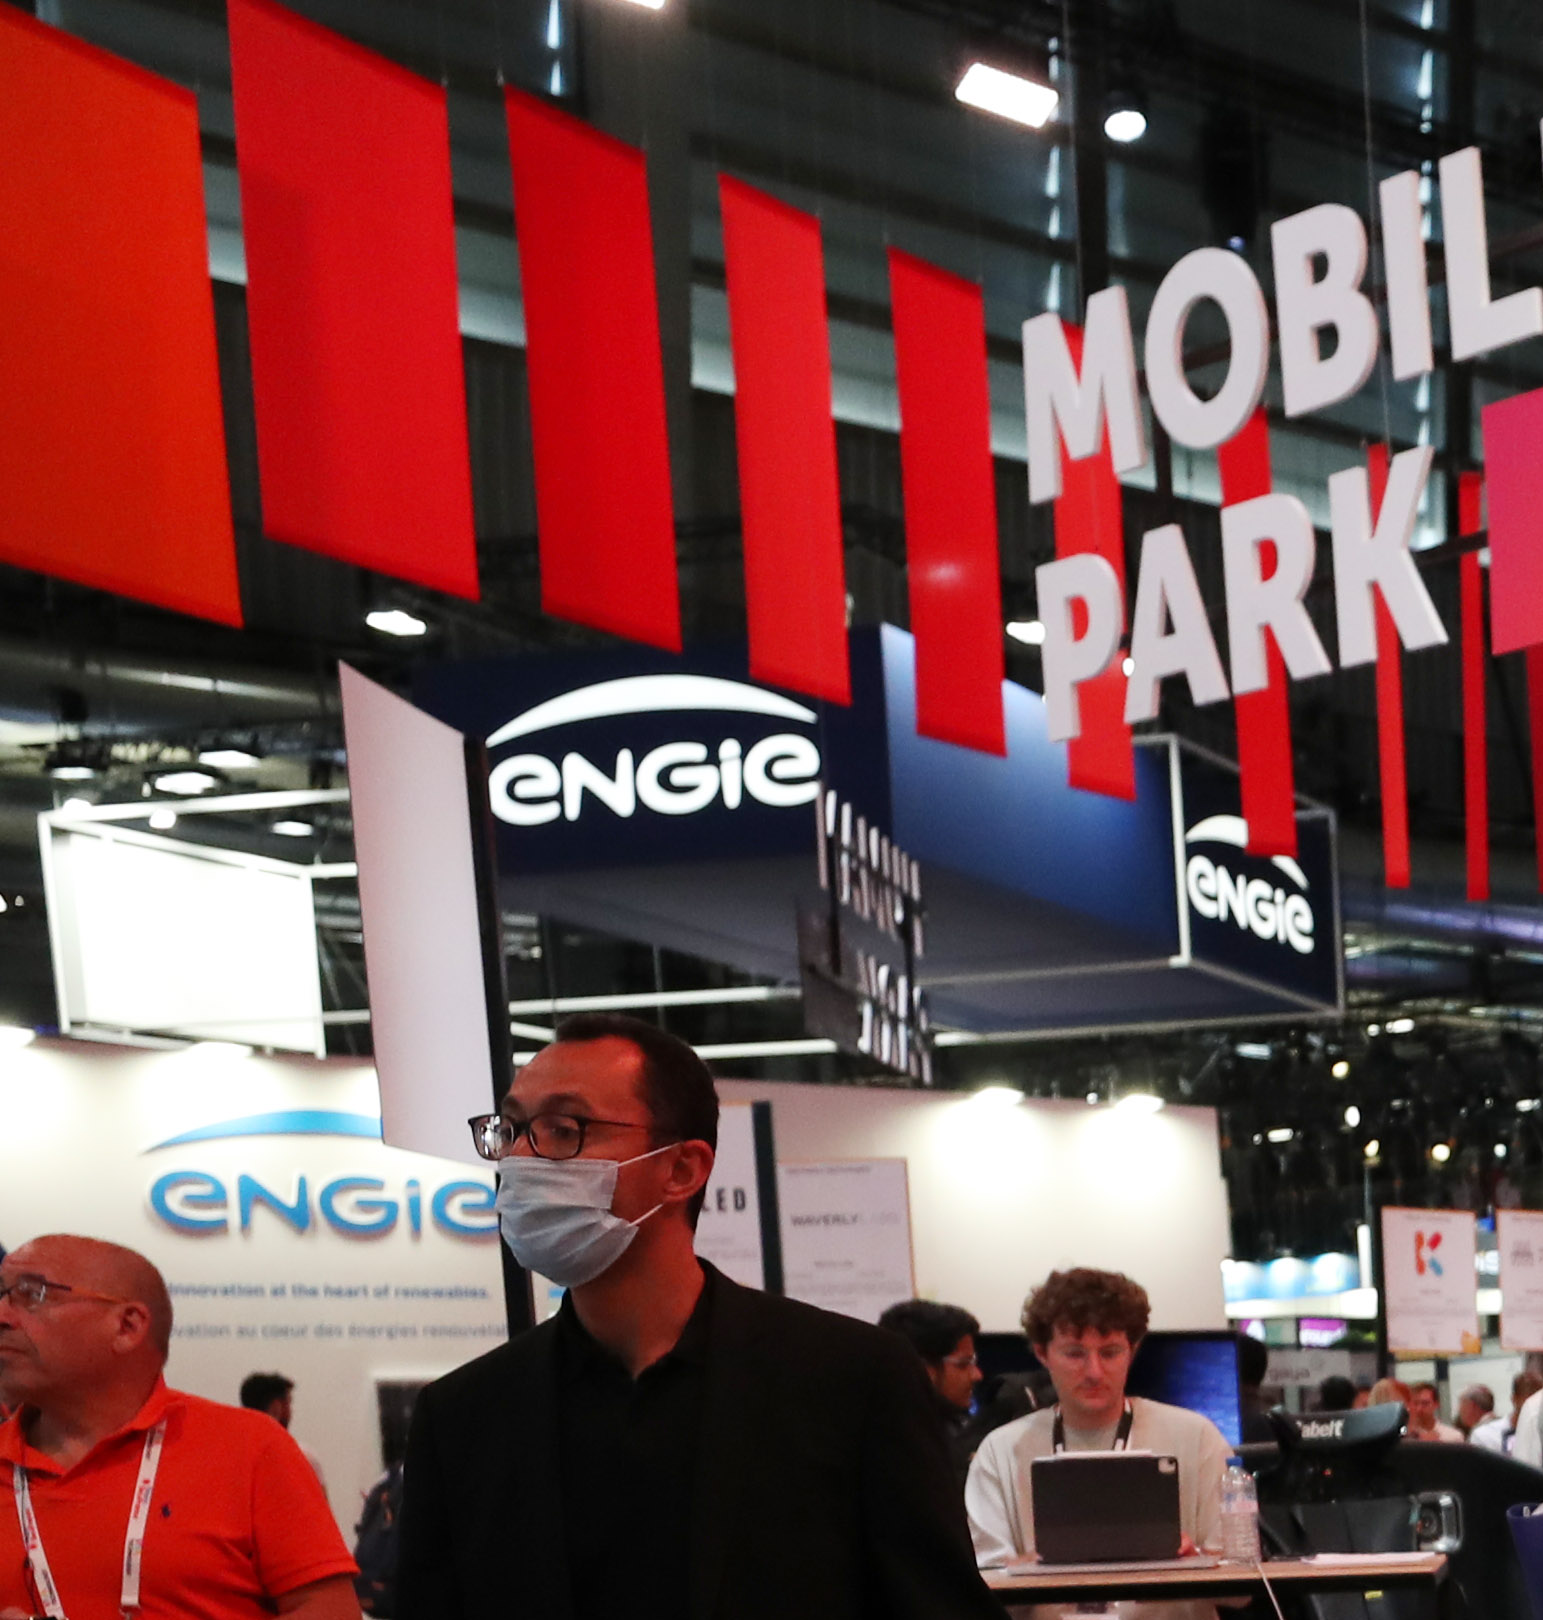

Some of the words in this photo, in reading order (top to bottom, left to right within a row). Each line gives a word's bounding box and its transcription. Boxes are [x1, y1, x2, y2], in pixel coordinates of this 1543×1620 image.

[1035, 445, 1450, 743] PARK
[291, 1282, 318, 1297] the
[323, 1283, 368, 1298] heart
[373, 1283, 390, 1298] of
